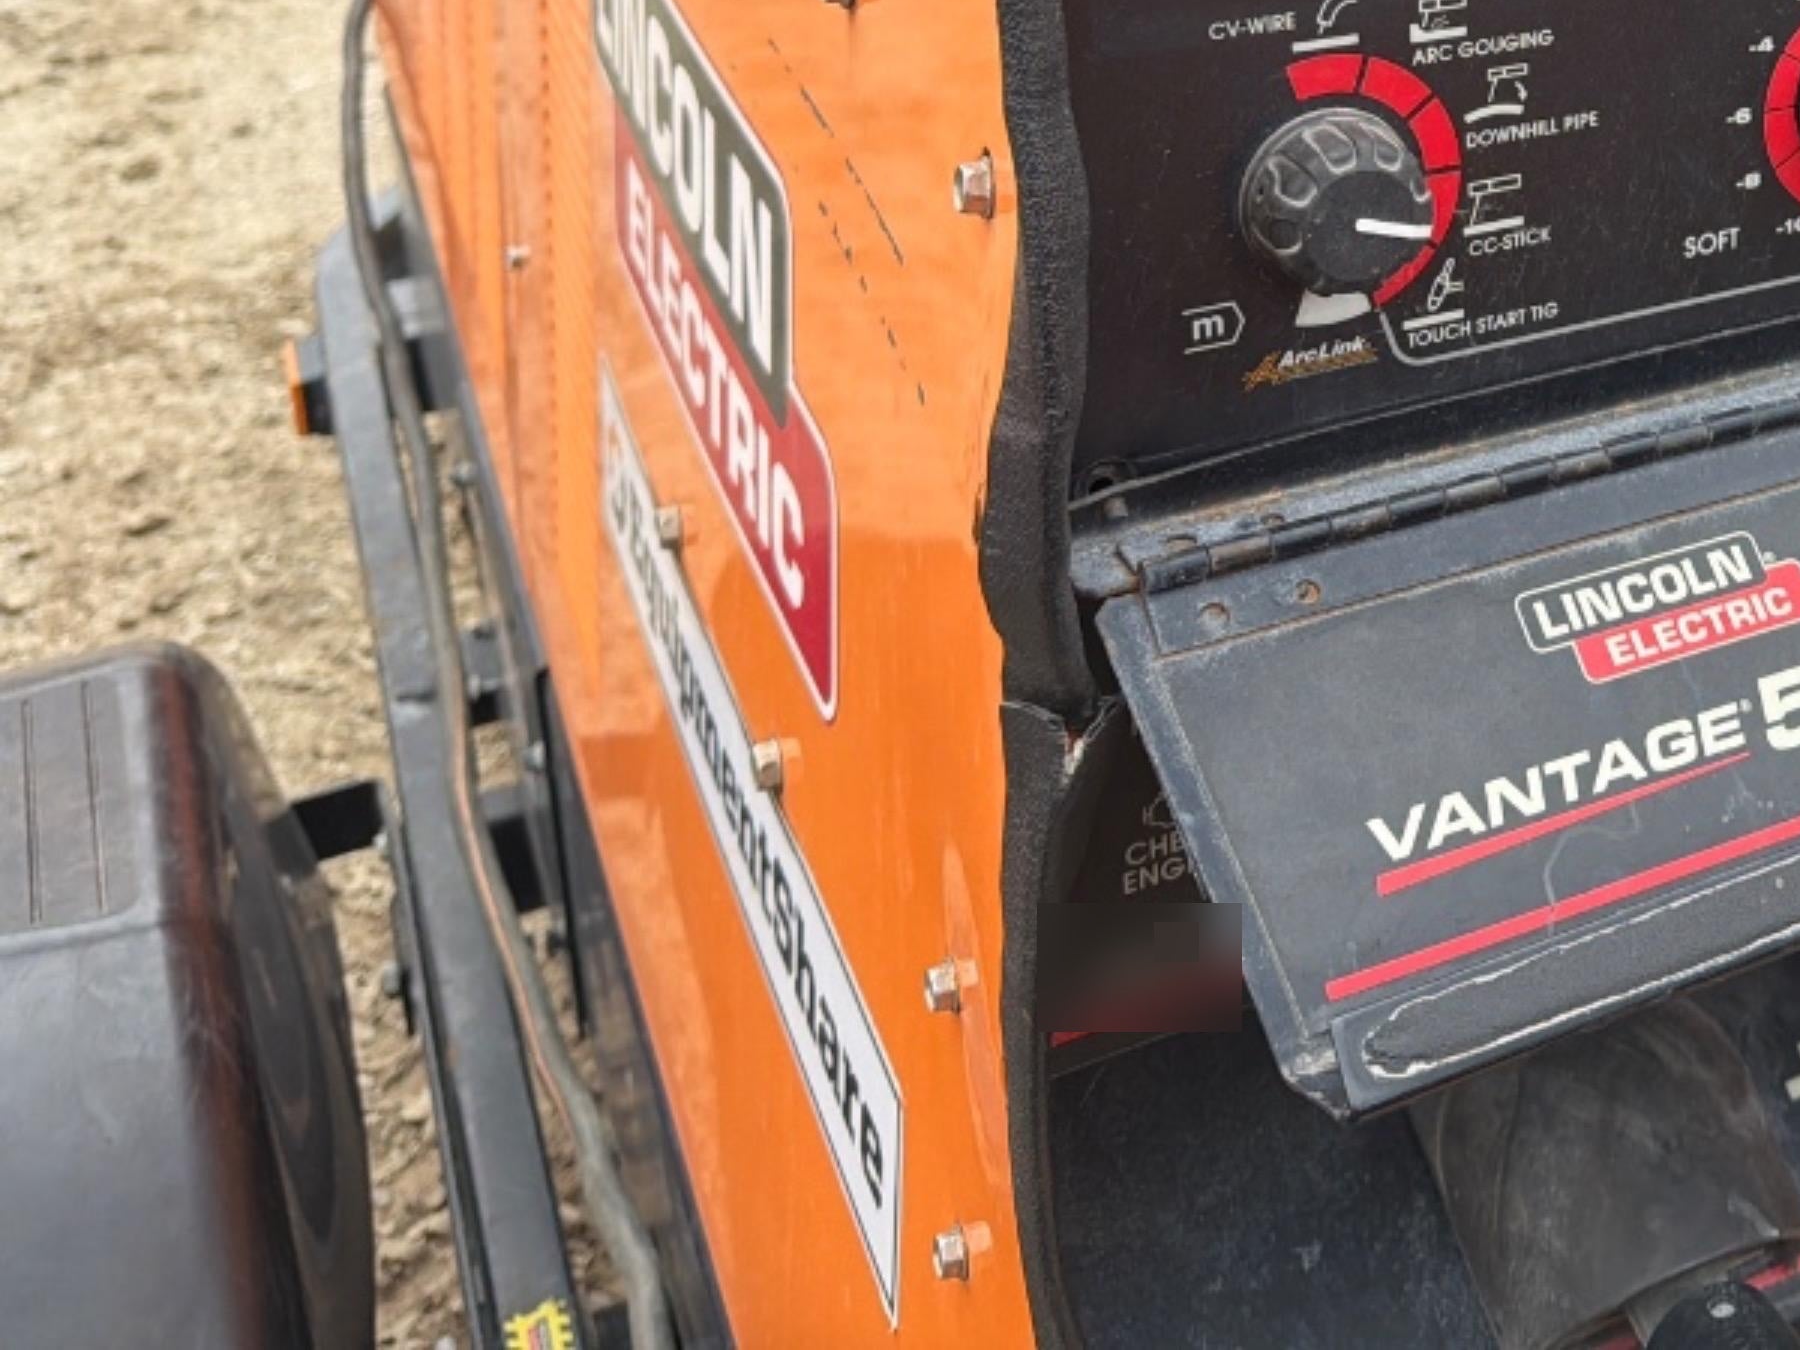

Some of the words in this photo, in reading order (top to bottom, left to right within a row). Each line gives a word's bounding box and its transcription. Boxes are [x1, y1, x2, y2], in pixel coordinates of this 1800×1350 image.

[1208, 12, 1297, 41] CV-WIRE
[1748, 36, 1775, 53] -4
[1411, 42, 1453, 66] ARC
[1457, 29, 1555, 59] GOUGING
[1465, 116, 1559, 149] DOWNHILL
[1562, 110, 1599, 132] PIPE
[1726, 107, 1752, 125] -6
[1735, 172, 1762, 190] -8
[1468, 226, 1553, 256] CC-STICK
[1684, 228, 1740, 259] SOFT
[1408, 321, 1472, 348] TOUCH
[1475, 309, 1528, 335] START
[1529, 302, 1559, 322] TIG
[626, 160, 806, 610] ELECTRIC
[1533, 543, 1754, 639] LINCOLN
[1604, 587, 1794, 667] ELECTRIC
[1364, 700, 1748, 863] VANTAGE
[1124, 828, 1187, 866] CHE
[1122, 856, 1199, 895] ENGI
